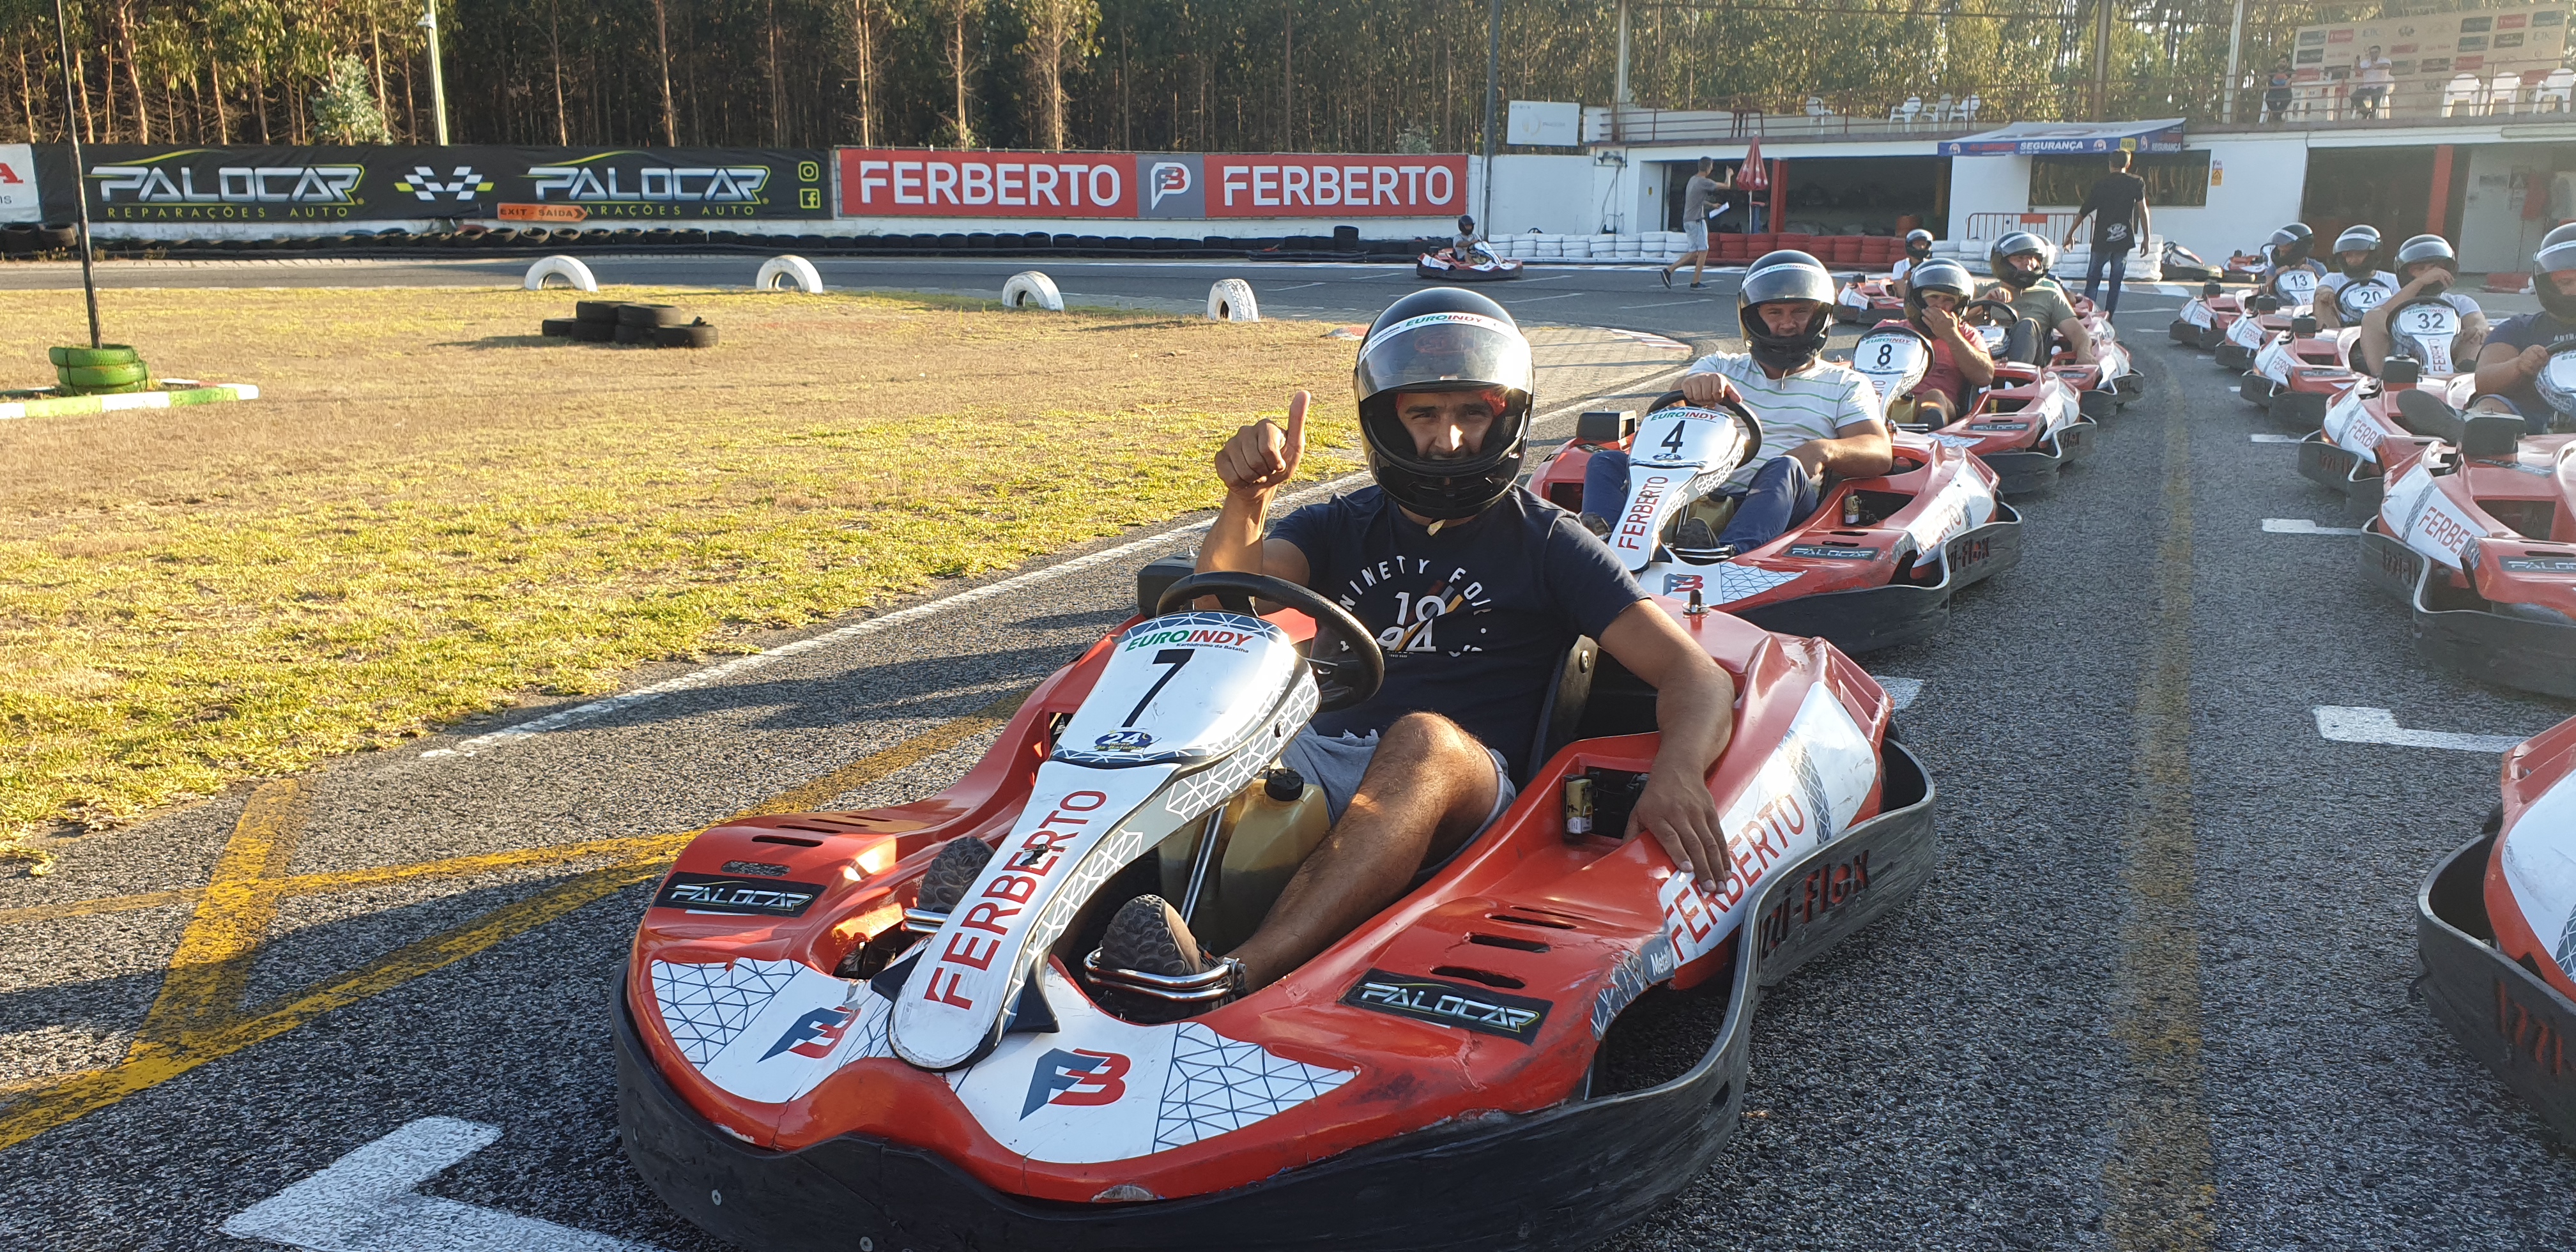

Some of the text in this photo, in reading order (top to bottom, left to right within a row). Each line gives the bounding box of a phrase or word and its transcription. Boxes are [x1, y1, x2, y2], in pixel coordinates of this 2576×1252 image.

[2020, 141, 2083, 151] SEGURANÇA
[91, 166, 362, 202] PALOCAR
[528, 167, 767, 201] PALOCAR
[861, 161, 1121, 206] FERBERTO
[1223, 165, 1453, 206] FERBERTO
[107, 204, 349, 220] REPARAÇÕES AUTO
[539, 208, 573, 217] SAÍDA
[586, 203, 754, 217] ARAÇÕES AUTO
[2291, 274, 2308, 289] 13
[2361, 291, 2382, 304] 20
[1405, 315, 1482, 327] EUROINDY
[2418, 313, 2445, 329] 32
[1877, 344, 1892, 367] 8
[1650, 412, 1717, 422] EUROINDY
[1660, 420, 1685, 454] 4
[1618, 476, 1669, 550] FERBERTO
[1792, 547, 1874, 557] PALOCAR
[1340, 555, 1430, 612] NINETY
[1124, 630, 1254, 652] EUROINDY
[1224, 645, 1249, 653] Batalha
[1121, 648, 1195, 728] 7
[1101, 732, 1142, 744] 24
[670, 884, 813, 910] PALOCAR
[924, 790, 1107, 1011] FERBERTO
[1361, 982, 1538, 1029] PALOCAR
